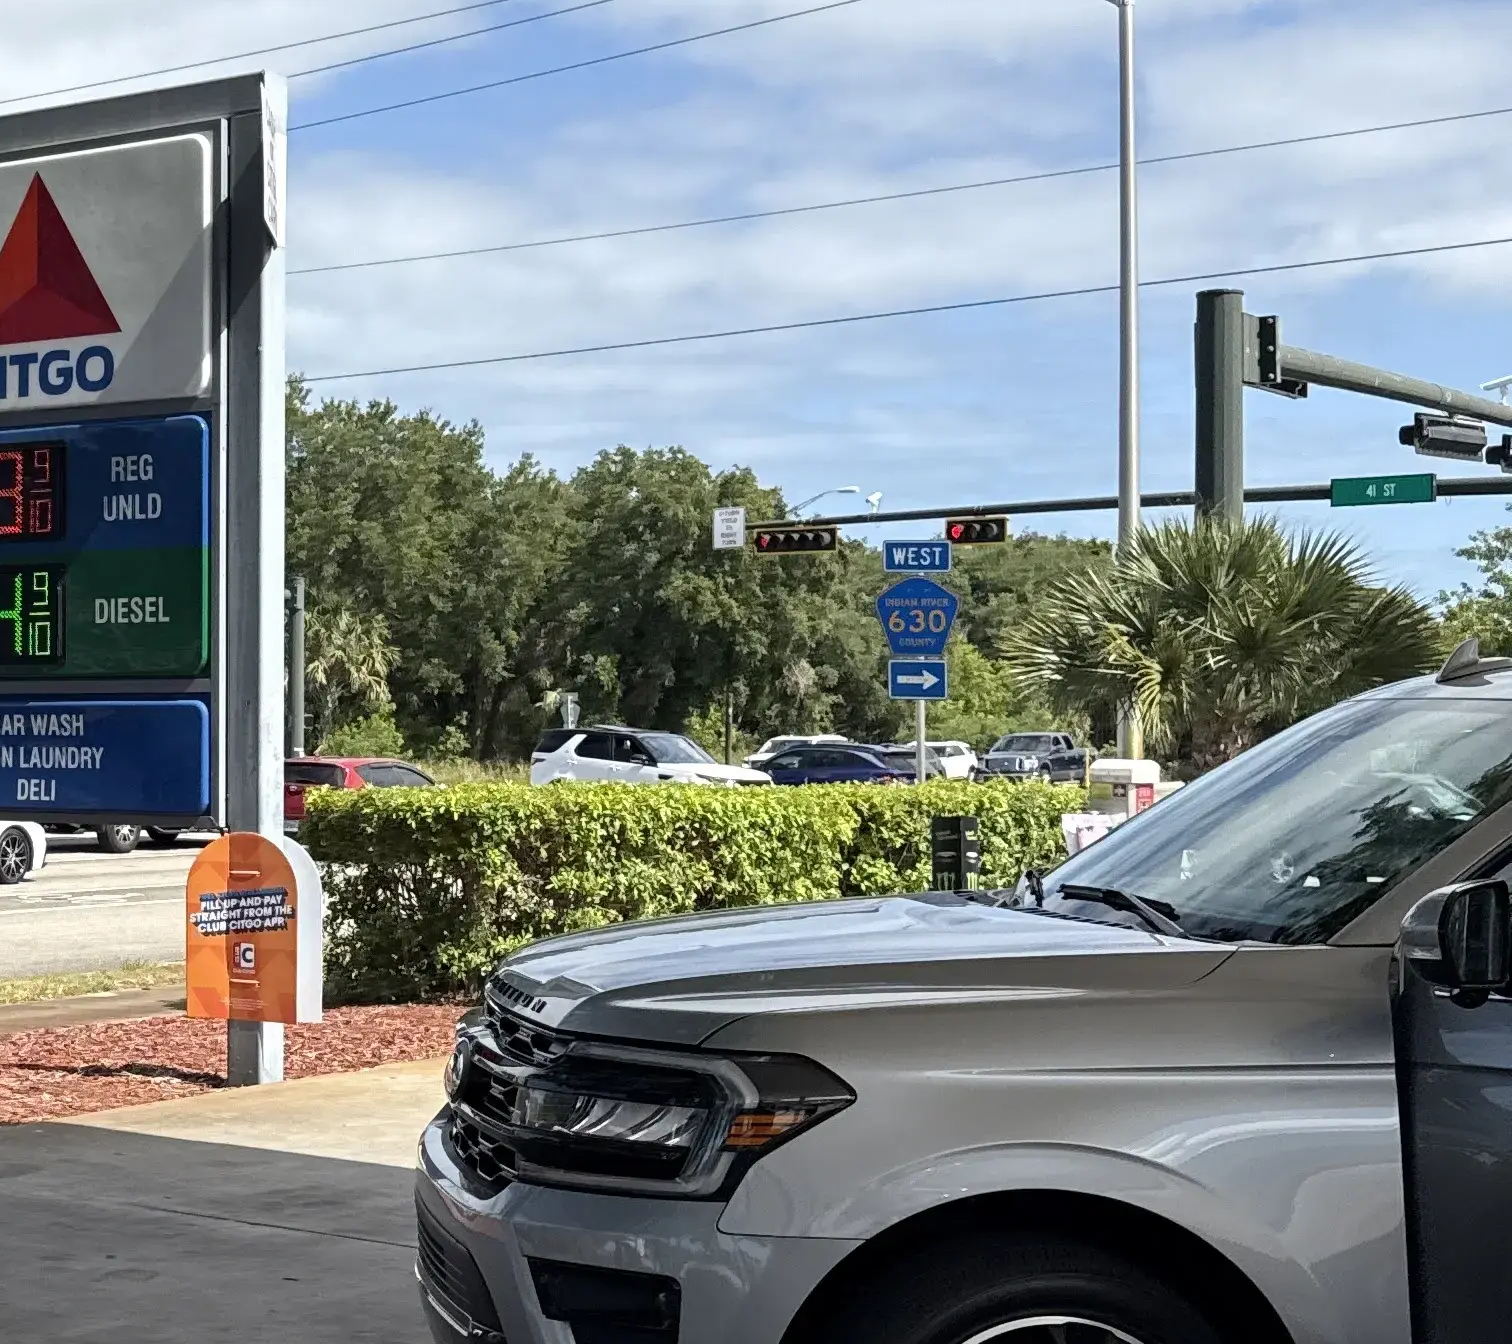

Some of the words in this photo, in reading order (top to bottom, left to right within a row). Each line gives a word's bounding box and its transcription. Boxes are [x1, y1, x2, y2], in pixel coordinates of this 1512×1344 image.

[111, 453, 154, 483] REG
[1366, 484, 1377, 498] 41
[1383, 483, 1396, 497] ST
[103, 493, 162, 522] UNLD
[893, 547, 942, 566] WEST
[94, 596, 170, 624] DIESEL
[885, 598, 918, 607] INDIAN
[921, 598, 949, 607] RIVER
[889, 609, 946, 633] 630
[899, 638, 936, 647] COUNTY
[30, 713, 84, 737] WASH
[19, 746, 104, 769] LAUNDRY
[17, 778, 56, 801] DELI
[200, 899, 222, 912] FILL
[223, 898, 238, 909] UP
[240, 896, 261, 908] AND
[263, 894, 283, 905] PAY
[189, 909, 241, 923] STRAIGHT
[244, 906, 272, 918] FROM
[275, 904, 293, 915] THE
[197, 920, 227, 933] CLUB
[228, 918, 262, 930] CITGO
[242, 947, 253, 963] C
